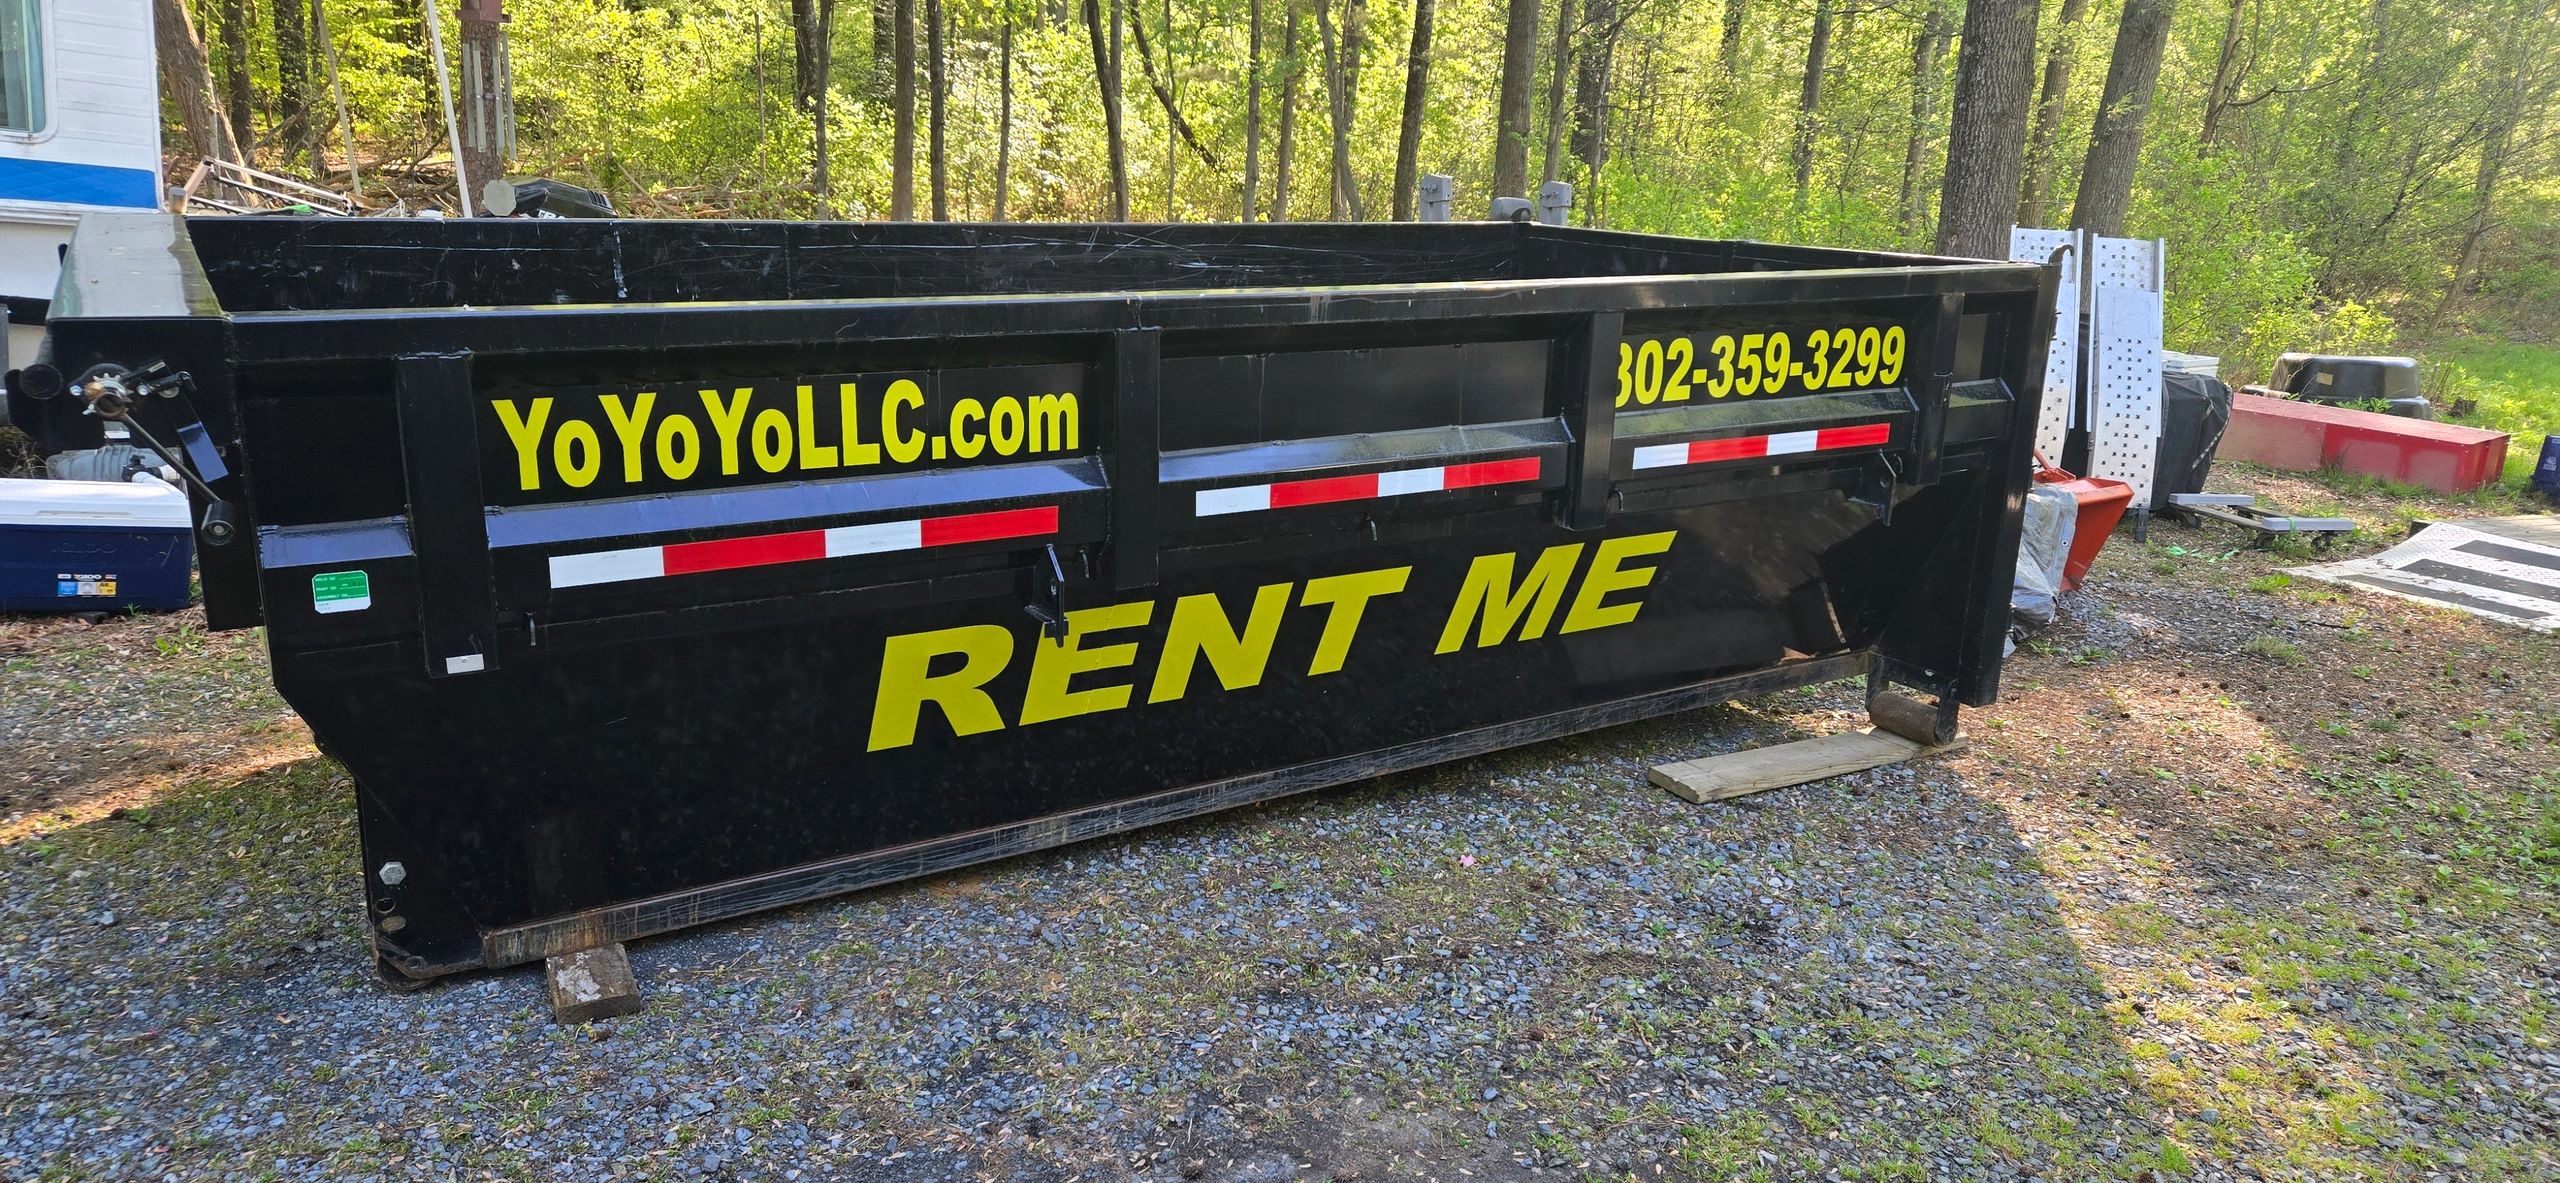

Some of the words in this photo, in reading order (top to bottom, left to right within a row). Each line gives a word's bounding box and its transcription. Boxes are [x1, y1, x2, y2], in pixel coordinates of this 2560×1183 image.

[1615, 325, 1907, 408] 302-359-3299
[491, 379, 1079, 491] YoYoYoLLC.com
[866, 566, 1413, 753] RENT
[1435, 531, 1678, 655] ME
